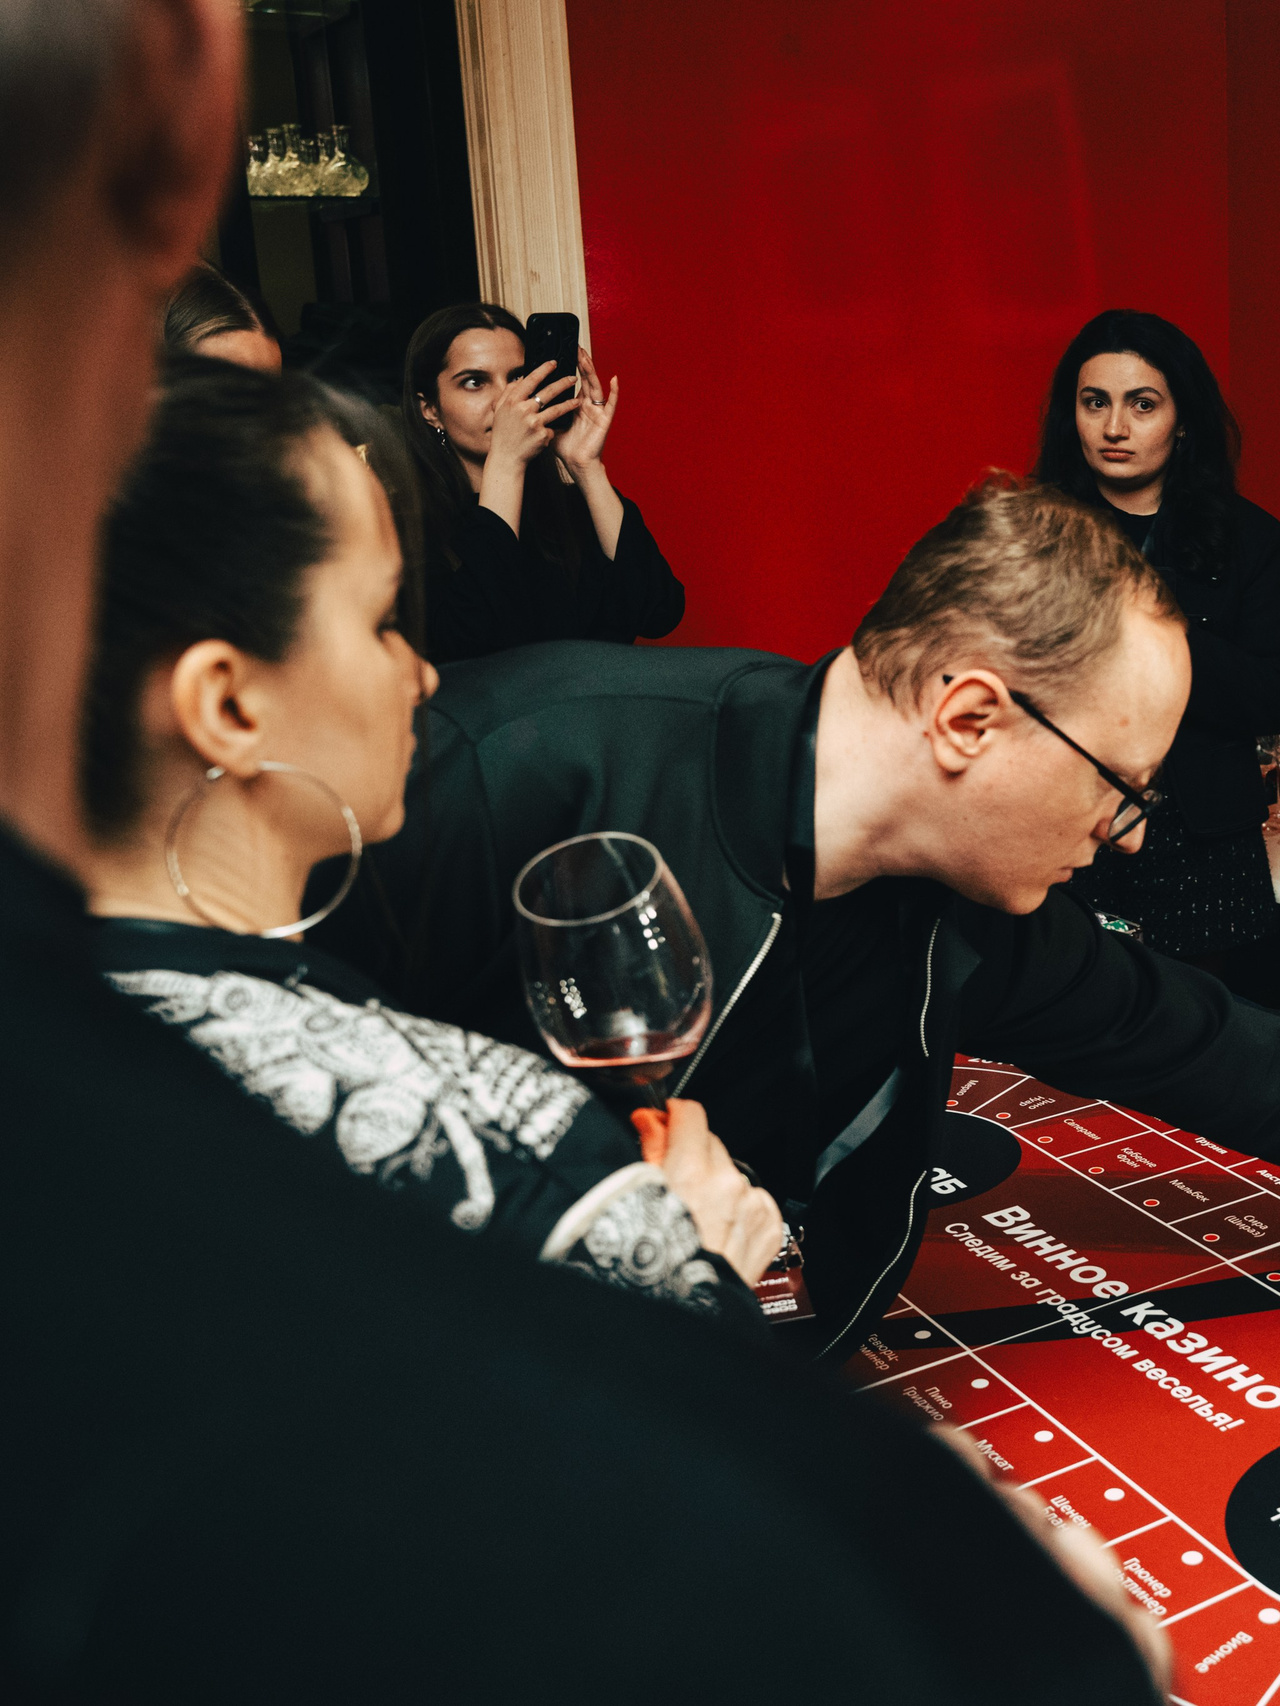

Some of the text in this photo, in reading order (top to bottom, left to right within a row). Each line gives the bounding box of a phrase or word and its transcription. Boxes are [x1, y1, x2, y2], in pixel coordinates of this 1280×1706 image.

[956, 1079, 979, 1097] Мерло
[1028, 1097, 1056, 1110] Пино
[1063, 1118, 1101, 1141] Саперави
[1195, 1136, 1229, 1155] Грузия
[1117, 1154, 1141, 1169] Фран
[1120, 1147, 1157, 1169] Каберне
[1169, 1179, 1210, 1203] Мальбек
[1224, 1215, 1266, 1238] (Шираз)
[1243, 1214, 1268, 1230] Сира
[981, 1205, 1129, 1299] Винное
[944, 1222, 1246, 1432] Следим за градусом веселья!
[859, 1344, 890, 1371] минер
[903, 1386, 944, 1421] Гриджио
[924, 1386, 953, 1410] Пино
[975, 1439, 1014, 1472] Мускат
[1050, 1495, 1092, 1529] Шенен
[1123, 1557, 1172, 1598] Грюнер
[1115, 1568, 1167, 1616] ьтлинер
[1195, 1630, 1254, 1674] Вионье
